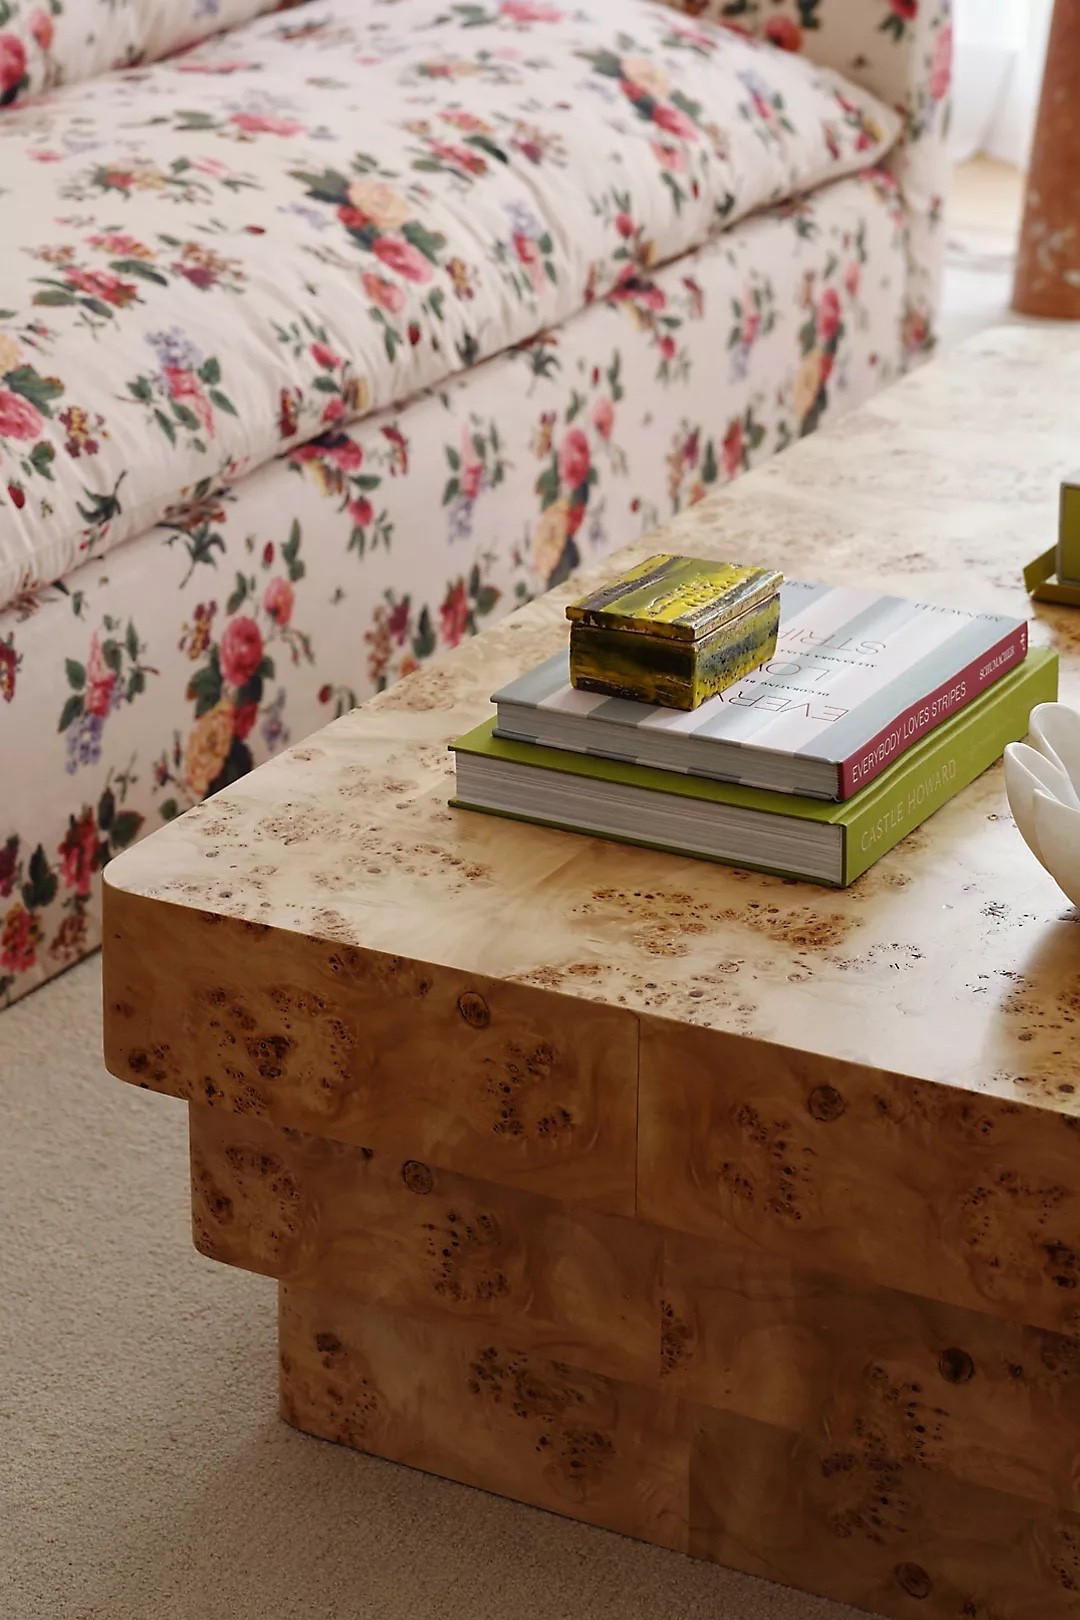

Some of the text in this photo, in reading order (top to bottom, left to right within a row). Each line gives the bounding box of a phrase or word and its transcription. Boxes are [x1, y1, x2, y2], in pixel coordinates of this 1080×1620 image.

[852, 681, 967, 783] EVERYBODY LOVES STRIPES
[860, 759, 957, 852] CASTLE HOWARD
